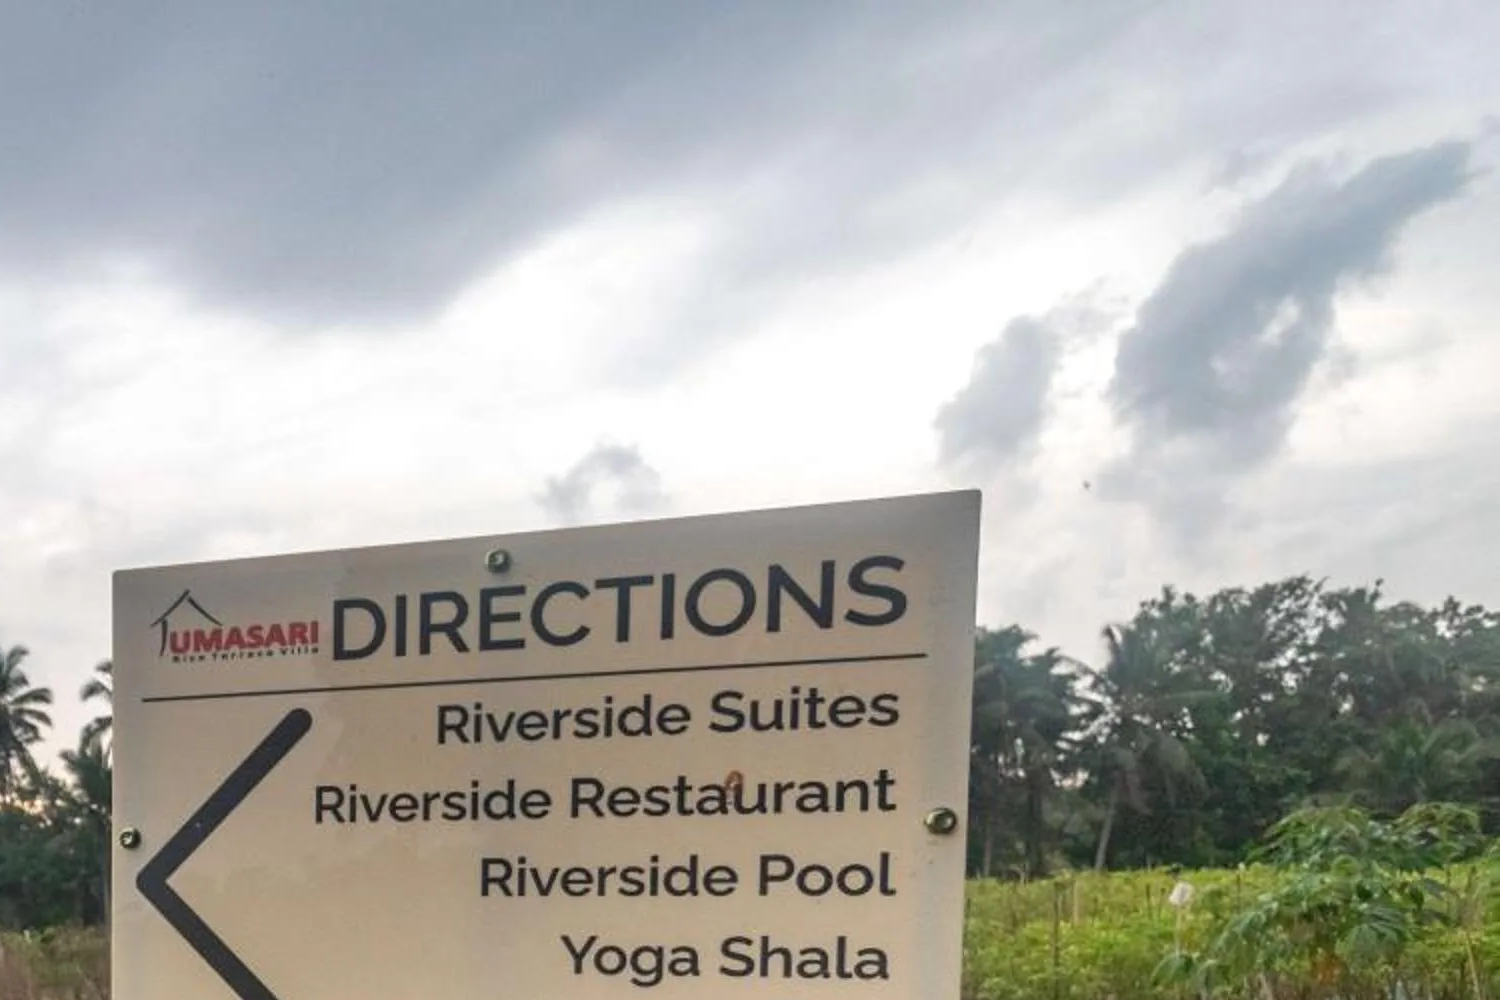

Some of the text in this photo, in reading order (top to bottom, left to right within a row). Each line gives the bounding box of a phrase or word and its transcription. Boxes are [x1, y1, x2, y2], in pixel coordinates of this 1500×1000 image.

[331, 555, 908, 662] DIRECTIONS
[170, 620, 319, 653] UMASARI
[437, 685, 901, 745] Riverside Suites
[314, 768, 898, 825] Riverside Restaurant
[479, 852, 898, 898] Riverside Pool
[559, 934, 891, 988] Yoga Shala
